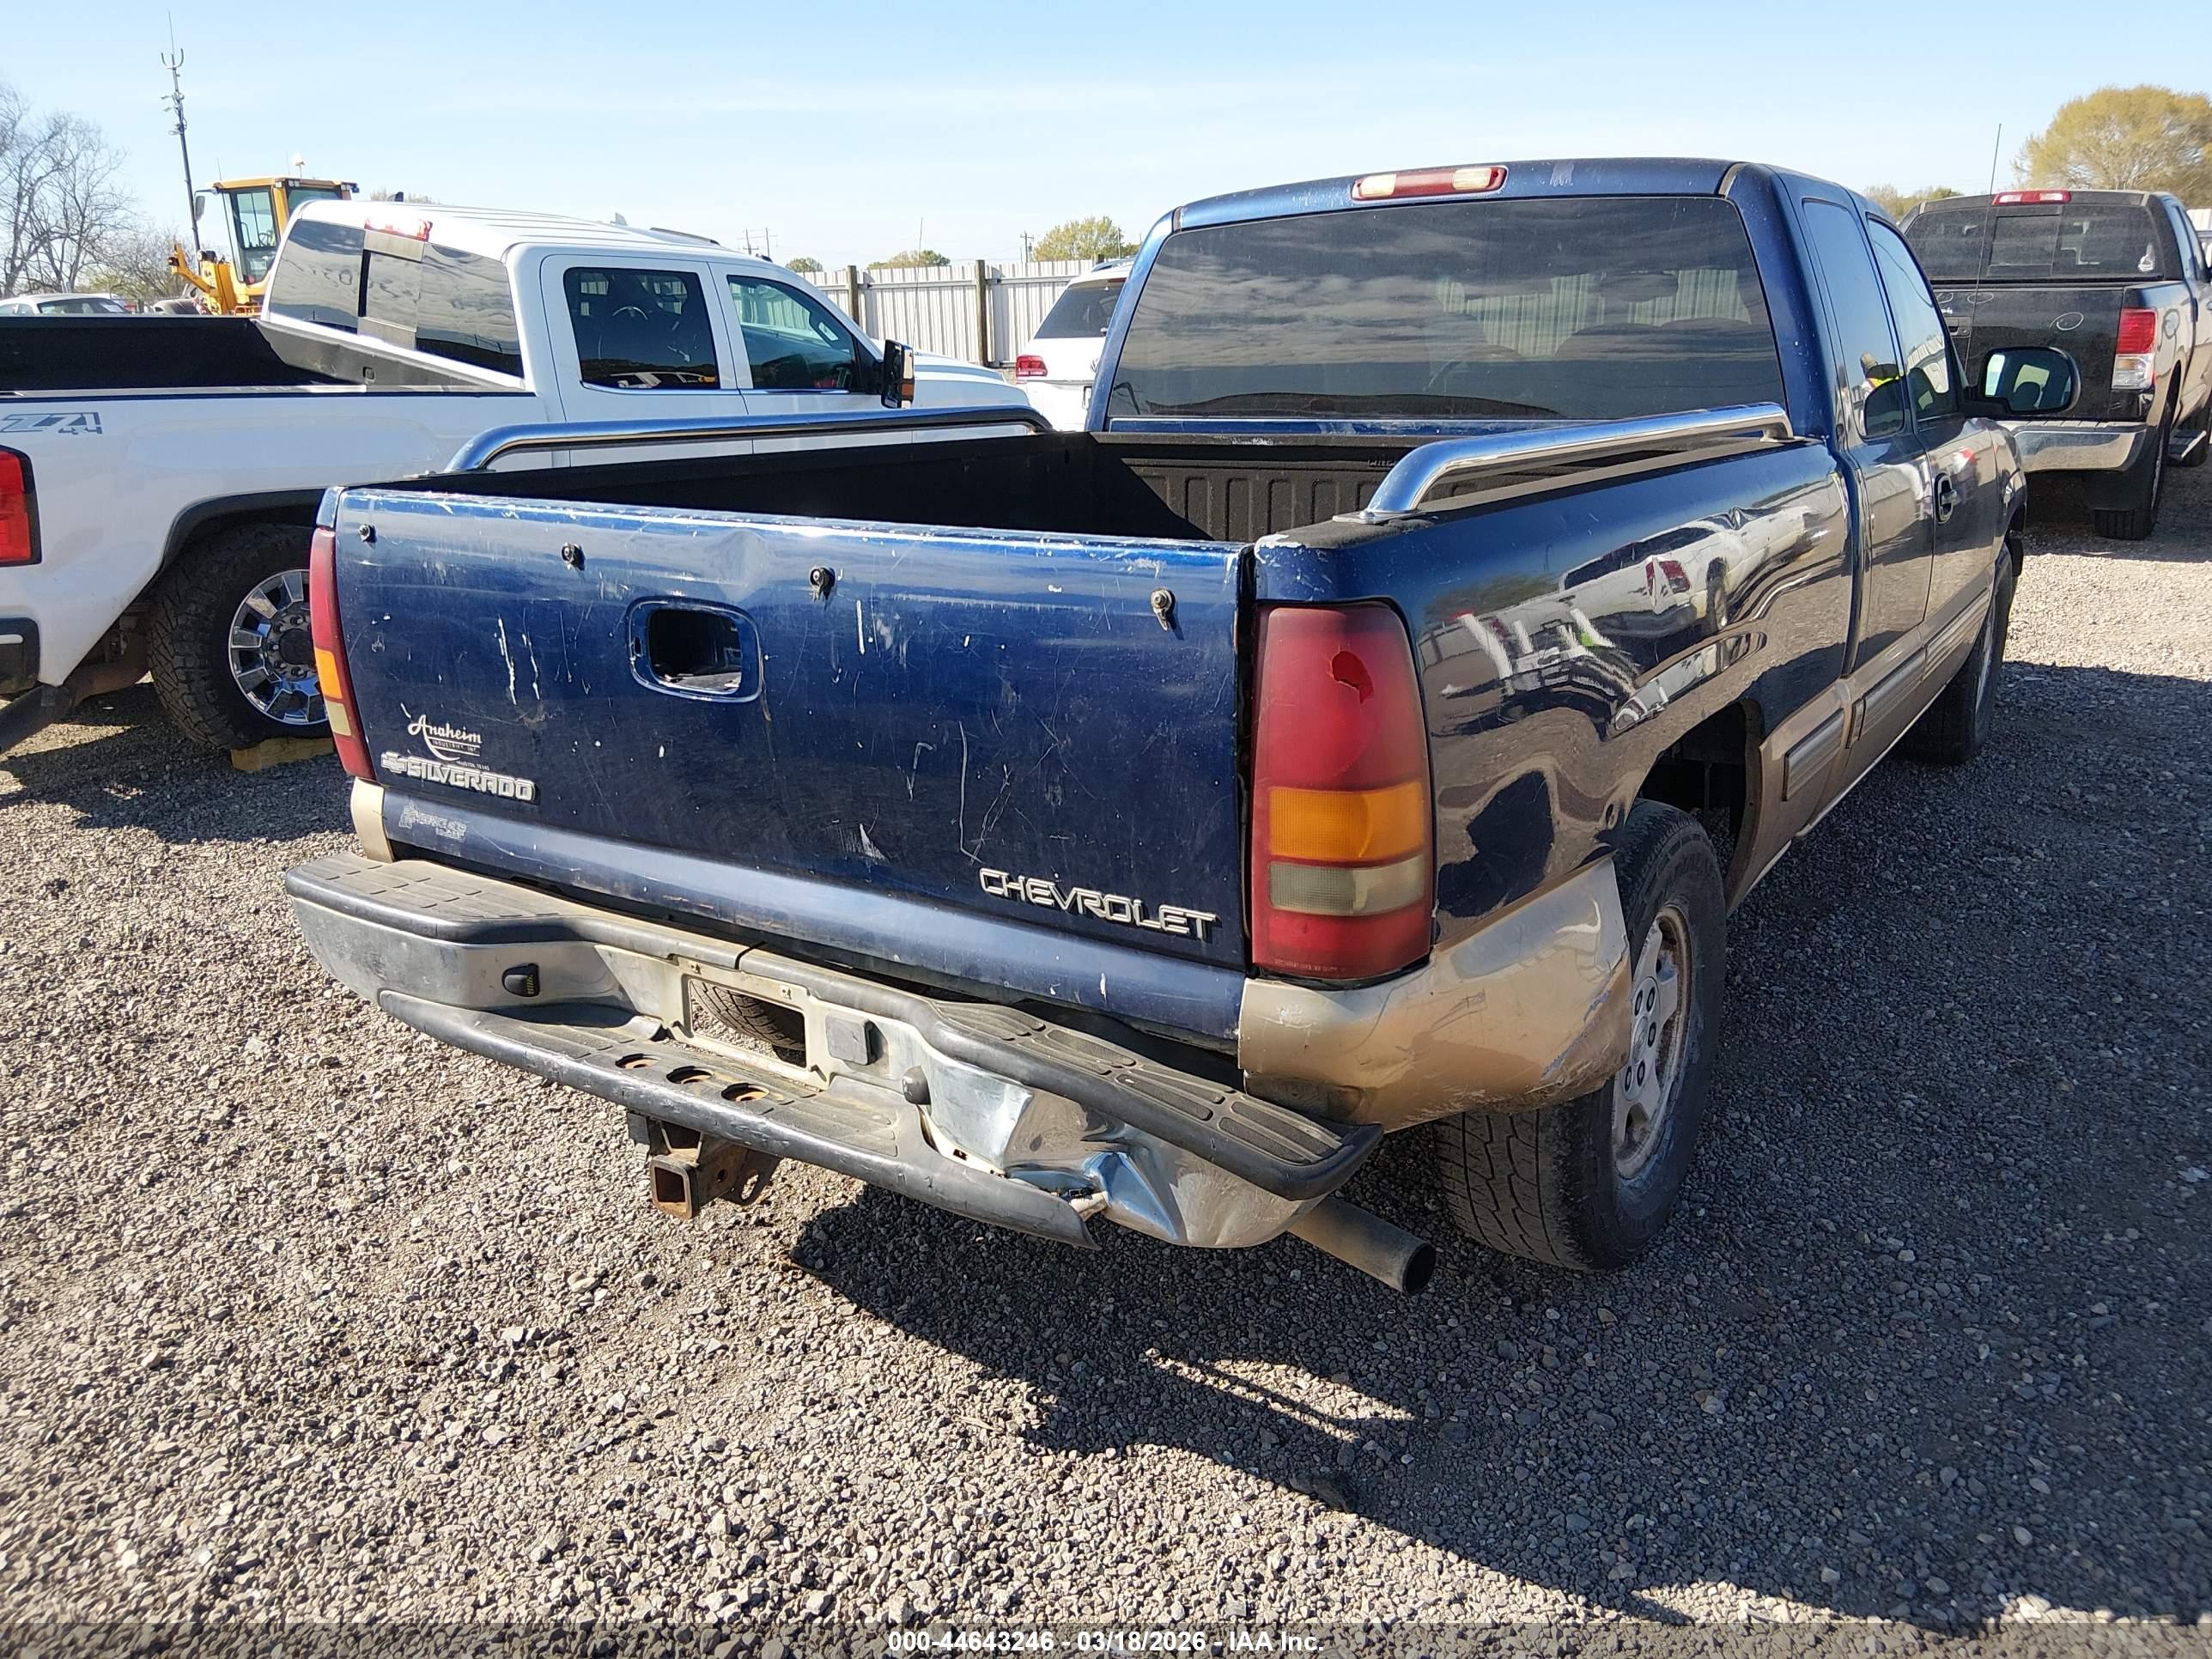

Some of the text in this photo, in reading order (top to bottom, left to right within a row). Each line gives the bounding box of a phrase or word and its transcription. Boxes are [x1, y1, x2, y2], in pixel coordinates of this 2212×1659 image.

[407, 714, 483, 751] Anaheim
[406, 756, 537, 802] SILVERADO
[979, 867, 1218, 939] CHEVROLET
